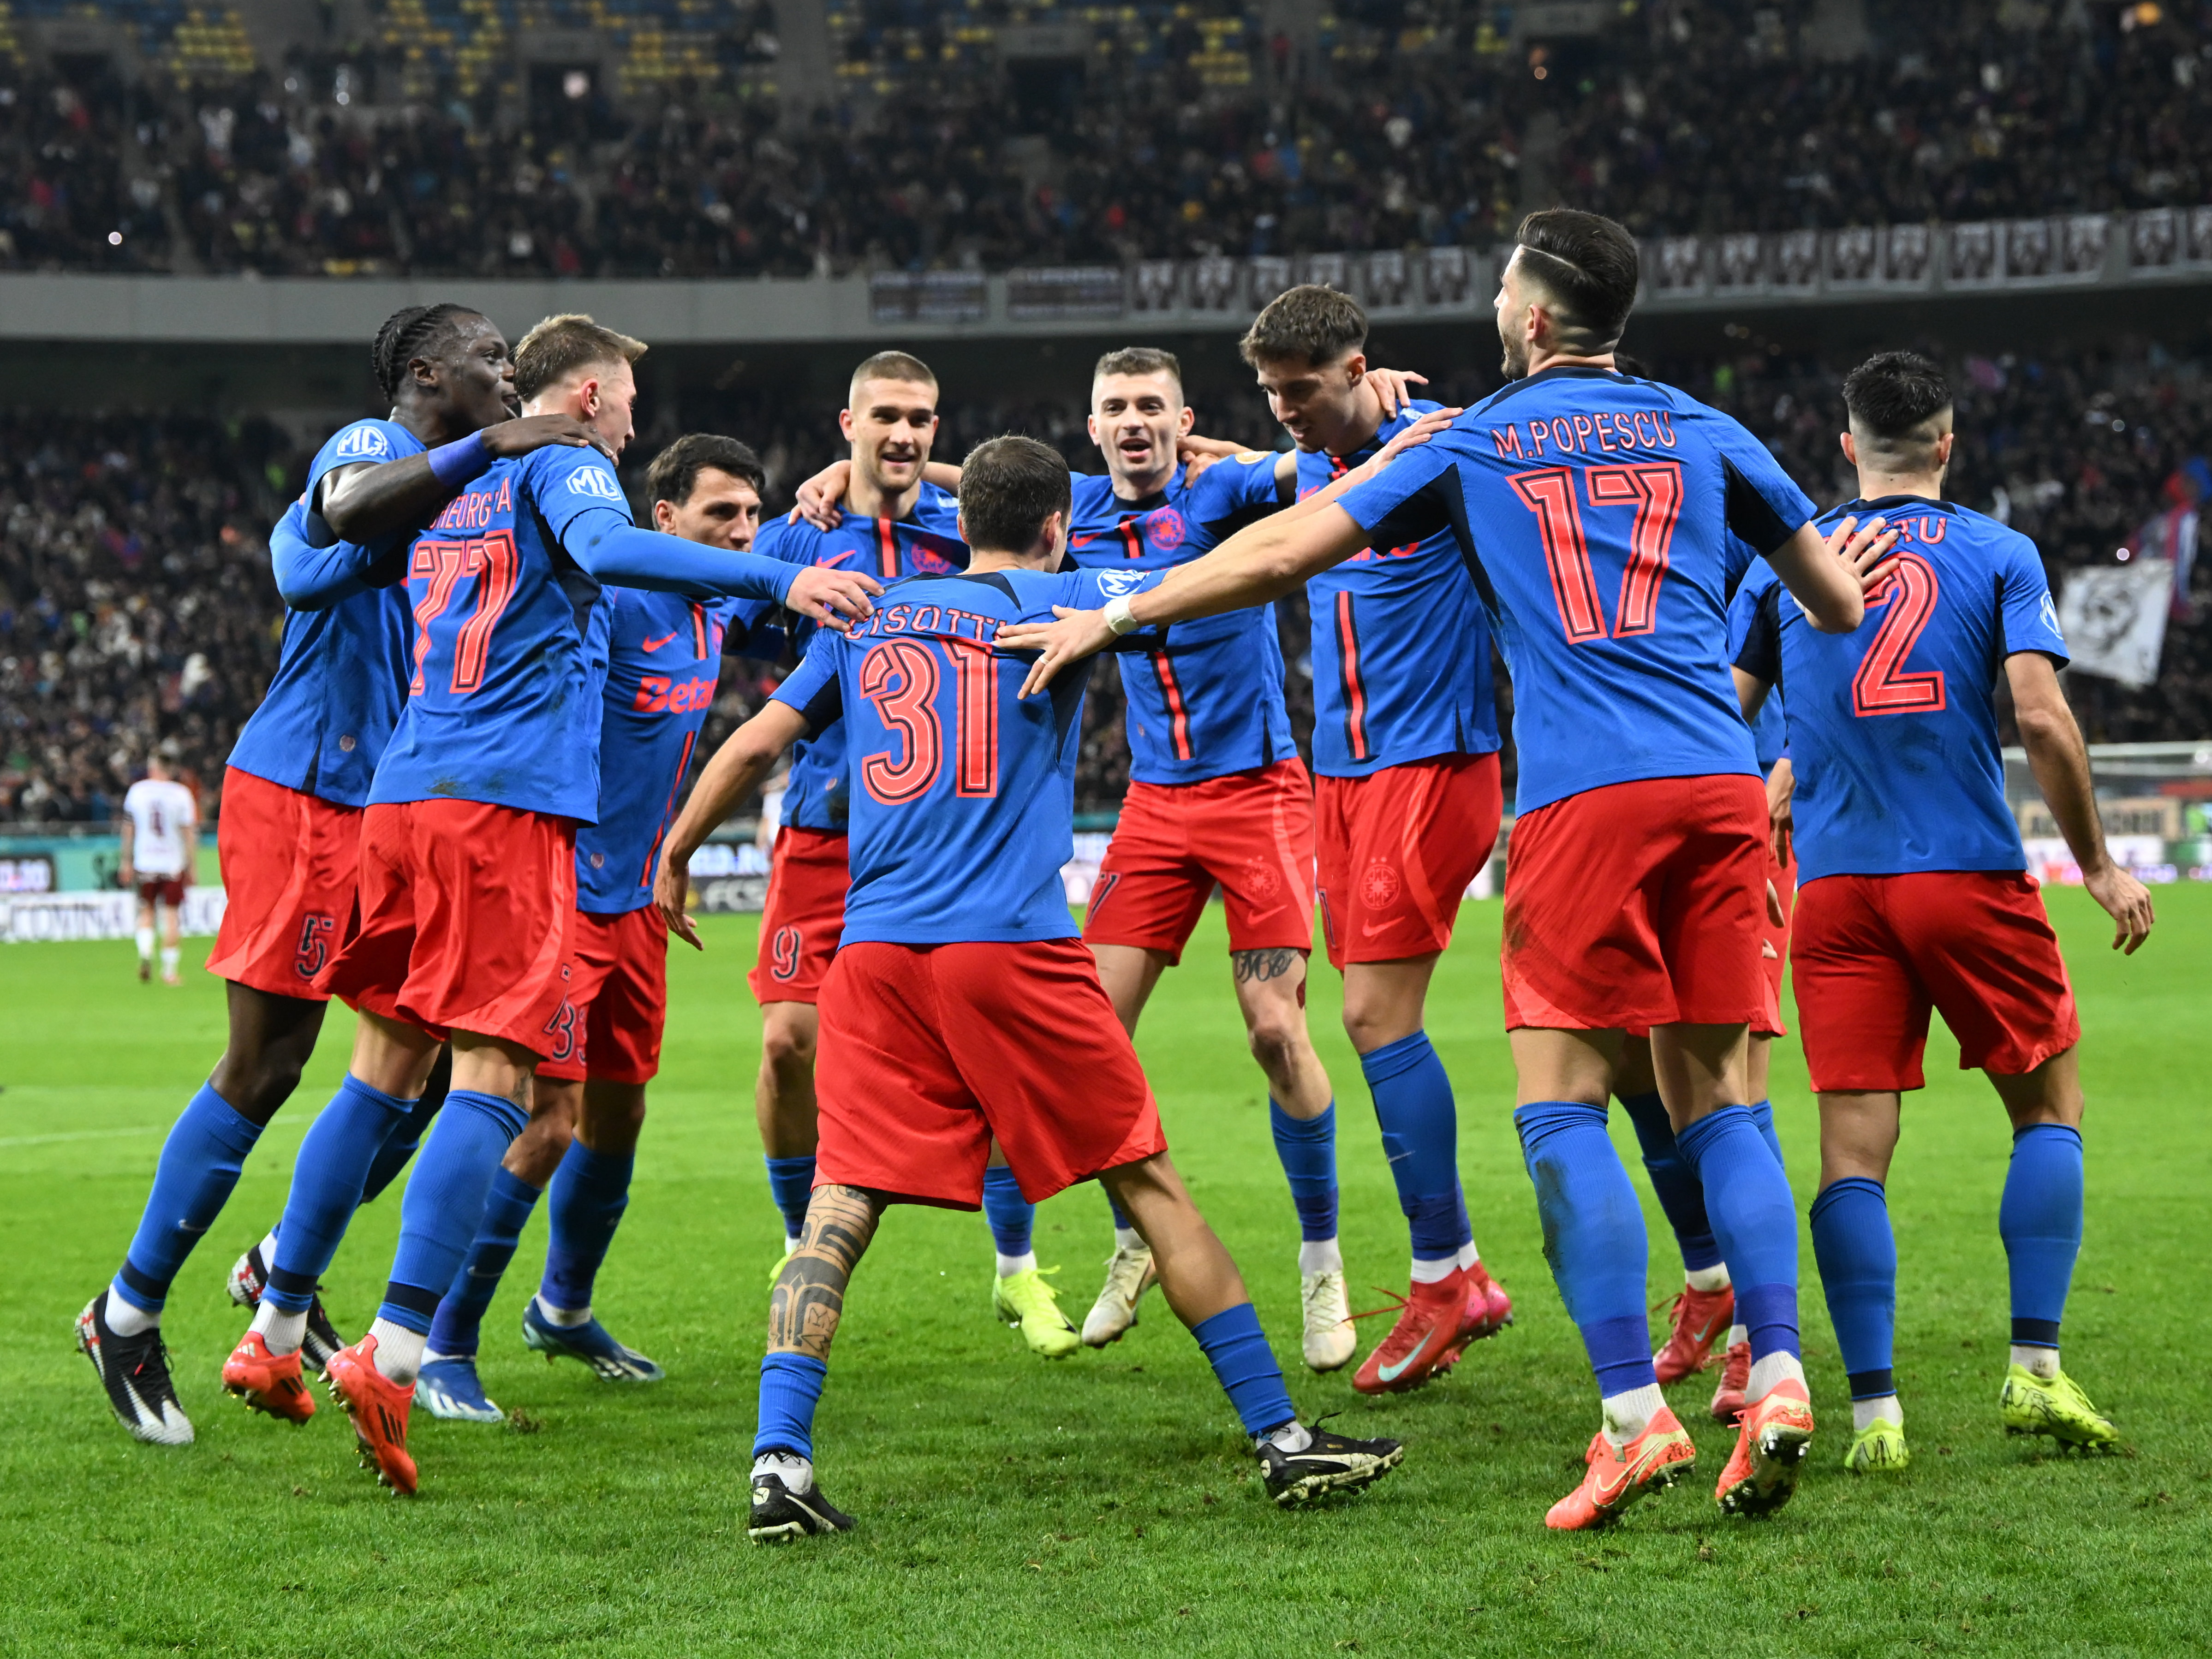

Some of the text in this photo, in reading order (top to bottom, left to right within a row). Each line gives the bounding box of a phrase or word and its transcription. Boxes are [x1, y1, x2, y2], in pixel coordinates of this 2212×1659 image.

[340, 428, 383, 453] MG
[1490, 410, 1676, 460] M.POPESCU
[572, 469, 618, 497] MG
[1506, 461, 1683, 645] 17
[409, 529, 518, 696] 77
[1853, 551, 1946, 718] 2
[859, 635, 998, 806] 31
[294, 912, 334, 981] 5
[770, 924, 803, 984] 9
